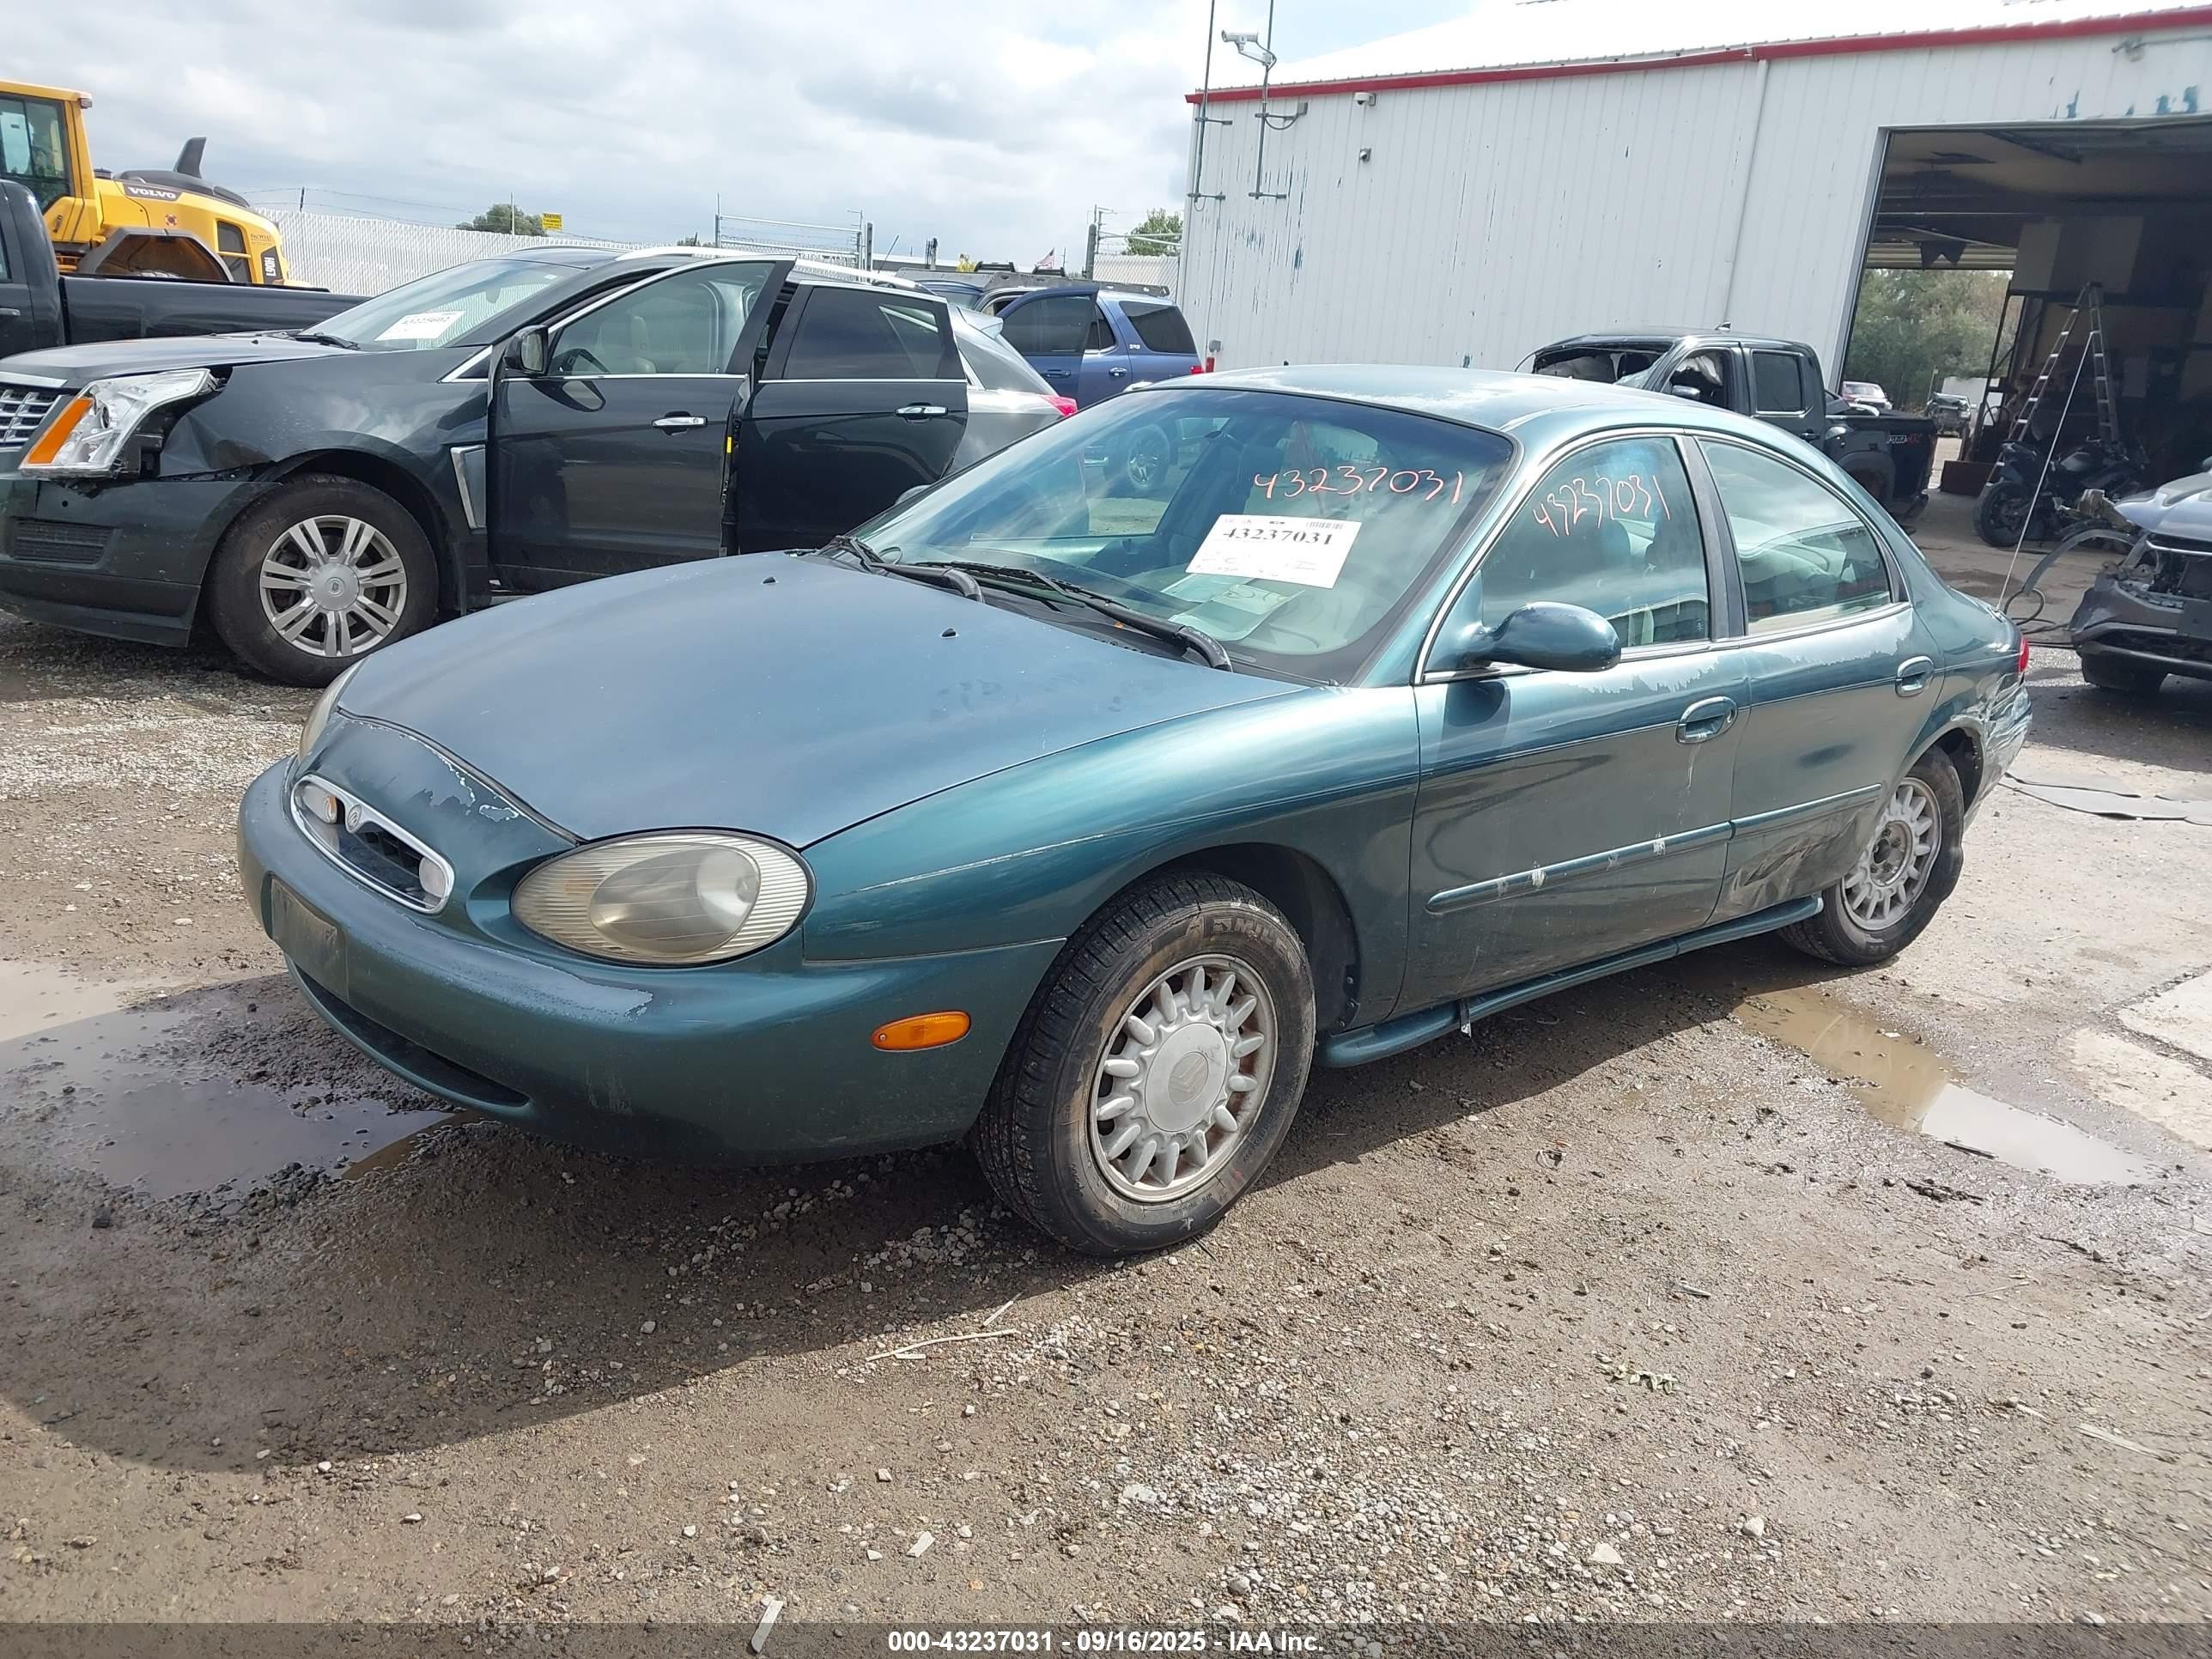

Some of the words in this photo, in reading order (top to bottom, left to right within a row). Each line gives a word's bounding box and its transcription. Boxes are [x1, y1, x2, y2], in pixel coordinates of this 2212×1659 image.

[127, 186, 176, 198] VOLVO
[1255, 465, 1462, 505] 43237031
[1533, 475, 1670, 538] 43237031
[1223, 526, 1333, 545] 43237031
